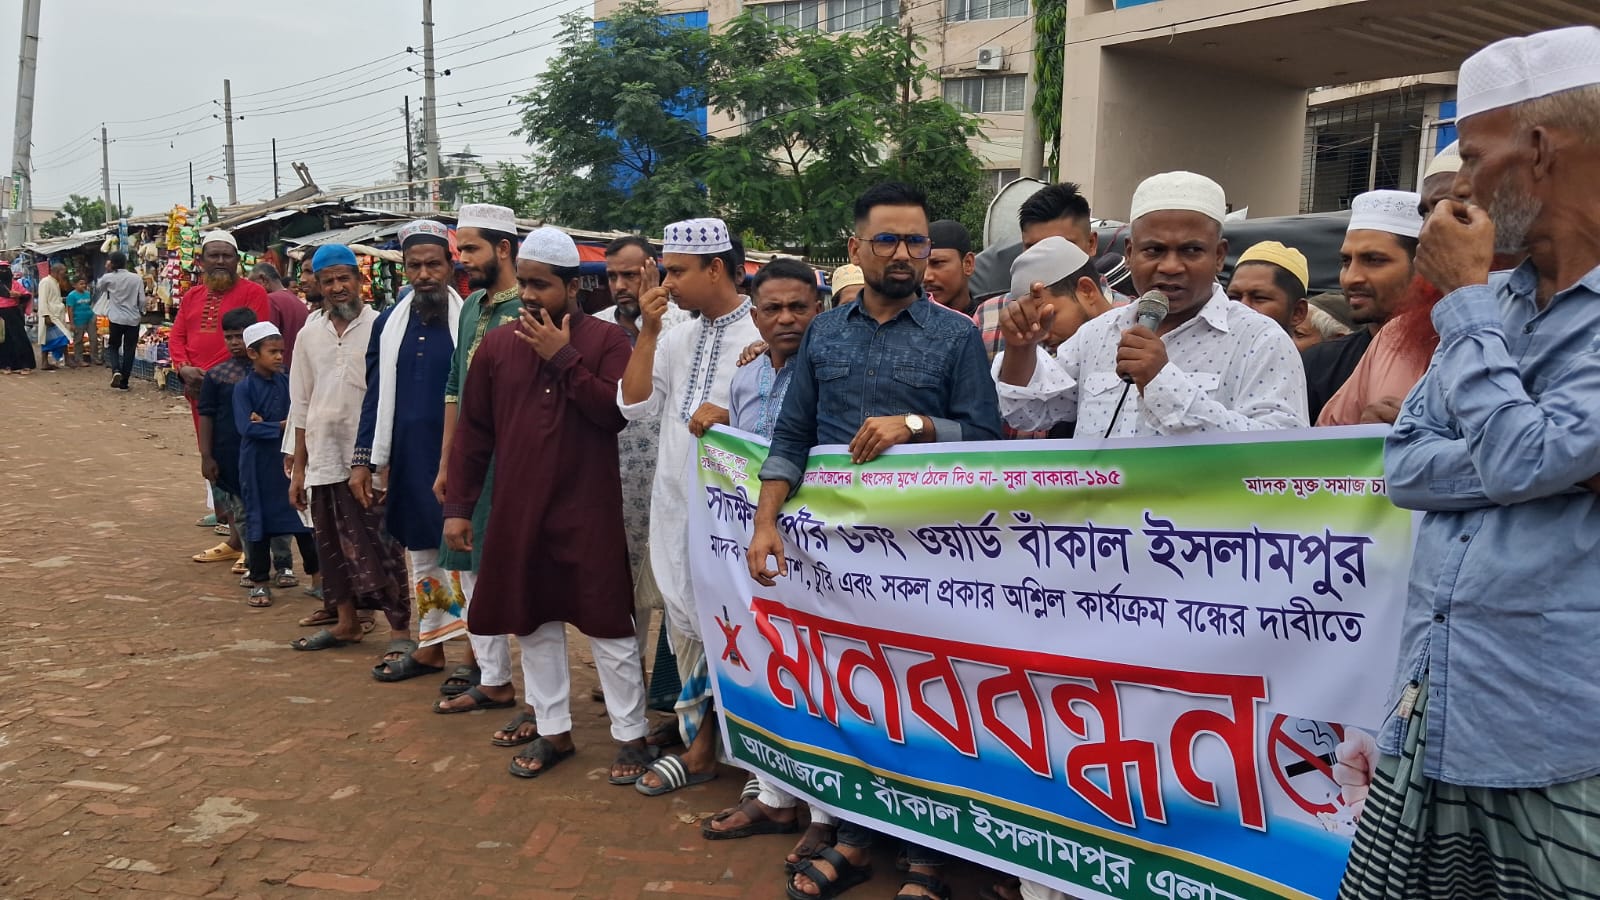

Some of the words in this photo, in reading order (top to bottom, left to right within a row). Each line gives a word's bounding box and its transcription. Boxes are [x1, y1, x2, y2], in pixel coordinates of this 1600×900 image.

[897, 471, 918, 488] মুখে
[922, 467, 948, 485] ঠেলে
[952, 466, 974, 485] দিও
[1003, 471, 1027, 489] সুরা
[1032, 470, 1120, 487] বাকারা-১৯৫
[1245, 477, 1287, 494] মাদক
[1291, 478, 1319, 496] মুক্ত
[1324, 477, 1367, 494] সমাজ
[1371, 477, 1386, 494] চা
[908, 512, 1001, 562] ওয়ার্ড
[1009, 512, 1133, 574] বাঁকাল
[1142, 511, 1374, 602] ইসলামপুর
[812, 561, 835, 596] চুরি
[838, 573, 877, 602] এবং
[880, 575, 931, 605] সকল
[937, 577, 996, 610] প্রকার
[1001, 576, 1067, 619] অশ্লিল
[1072, 583, 1169, 629] কার্যক্রম
[1175, 599, 1249, 638] বন্ধের
[1256, 596, 1366, 642] দাবীতে
[750, 597, 1270, 832] মানববন্ধন
[738, 732, 845, 800] আয়োজনে
[873, 776, 962, 834] বাঁকাল
[969, 801, 1134, 892] ইসলামপুর
[1145, 870, 1248, 900] এলা
